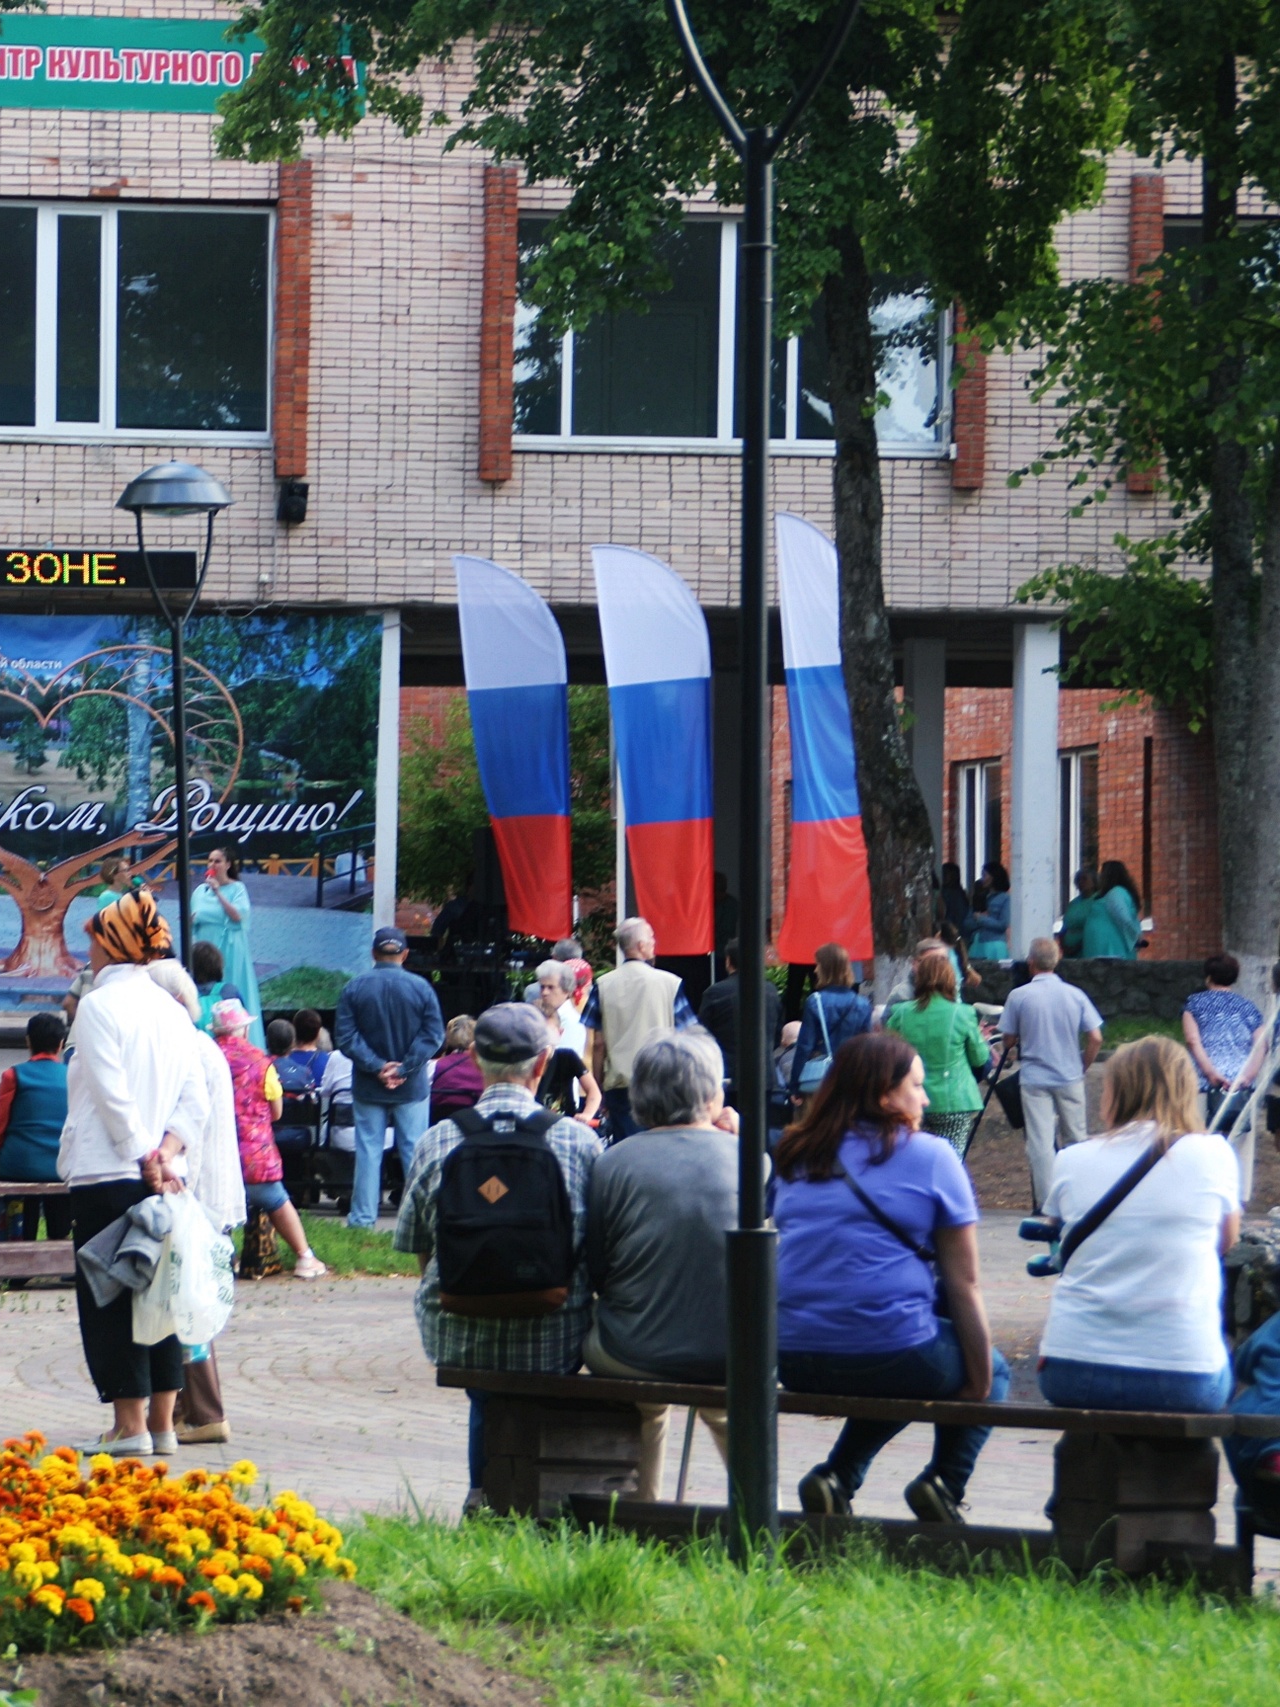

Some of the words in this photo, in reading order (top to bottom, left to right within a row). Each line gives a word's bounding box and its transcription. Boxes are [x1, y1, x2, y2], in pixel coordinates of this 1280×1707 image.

[47, 46, 244, 86] КУЛЬТУРНОГО
[5, 552, 127, 585] ЗОНЕ.
[11, 657, 63, 670] области
[133, 777, 365, 844] Рощино!
